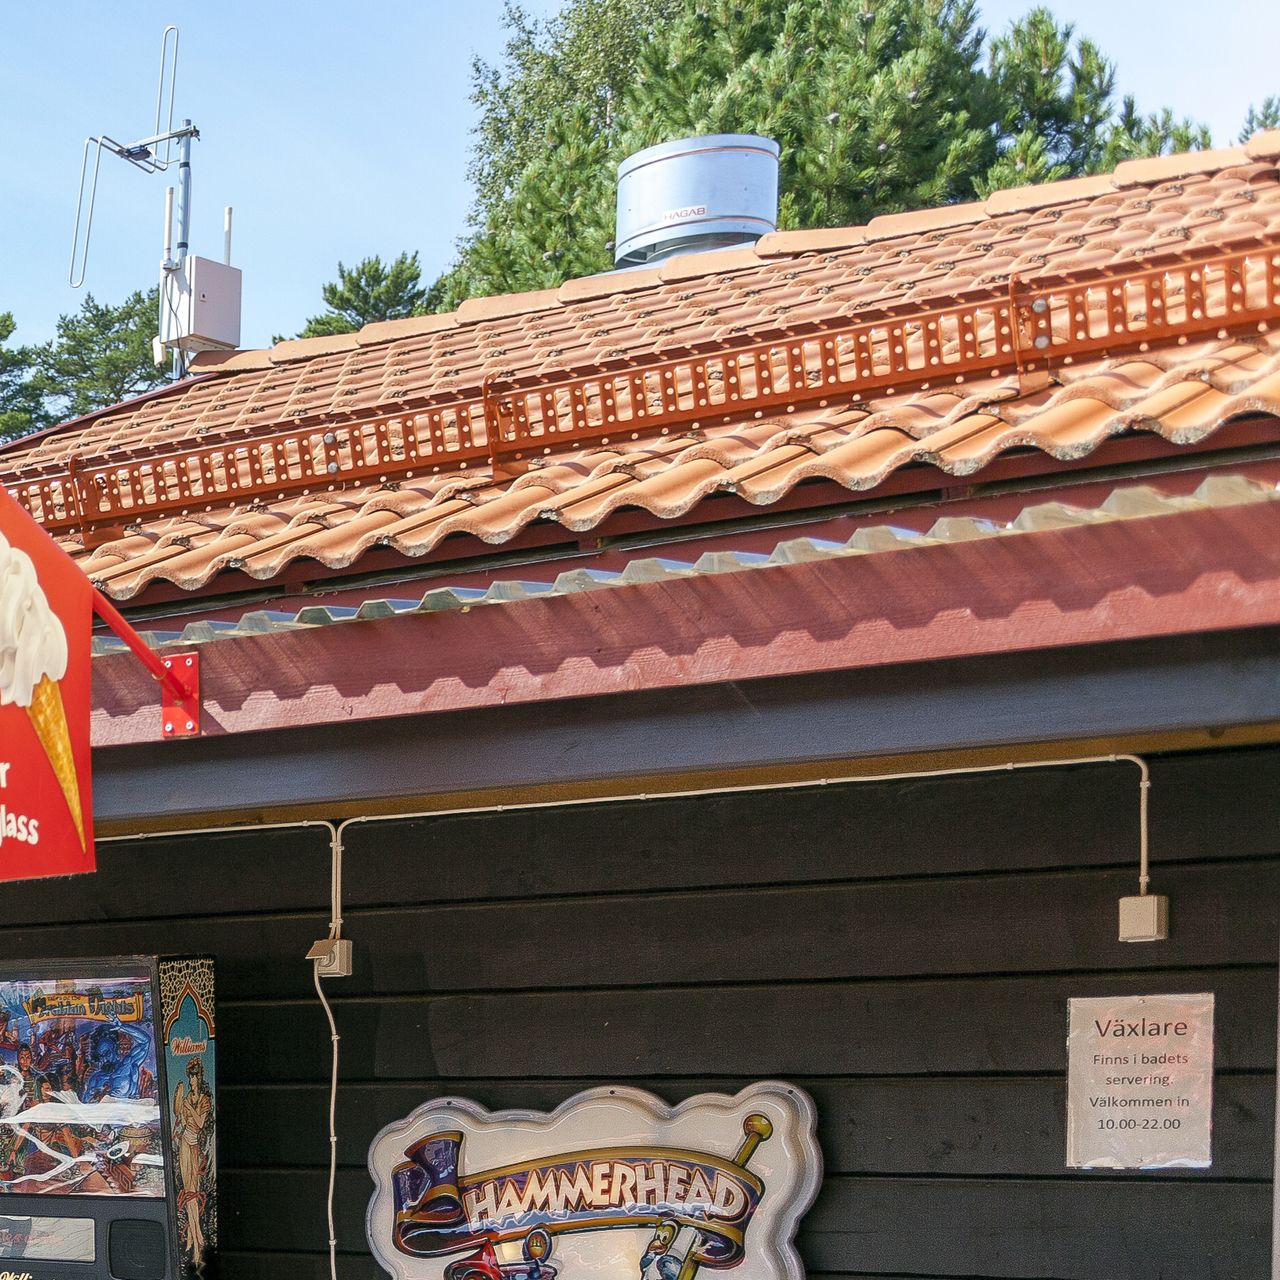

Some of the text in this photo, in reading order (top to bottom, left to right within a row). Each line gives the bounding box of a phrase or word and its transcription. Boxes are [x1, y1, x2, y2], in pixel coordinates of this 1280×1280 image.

[1094, 1017, 1189, 1038] Växlare
[171, 1037, 208, 1056] Williams
[1093, 1053, 1129, 1065] Finns
[1141, 1053, 1189, 1065] badets
[1105, 1074, 1174, 1087] servering.
[1089, 1095, 1190, 1108] Välkommen in
[1097, 1118, 1181, 1130] 10.00-22.00
[463, 1161, 748, 1229] HAMMERHEAD
